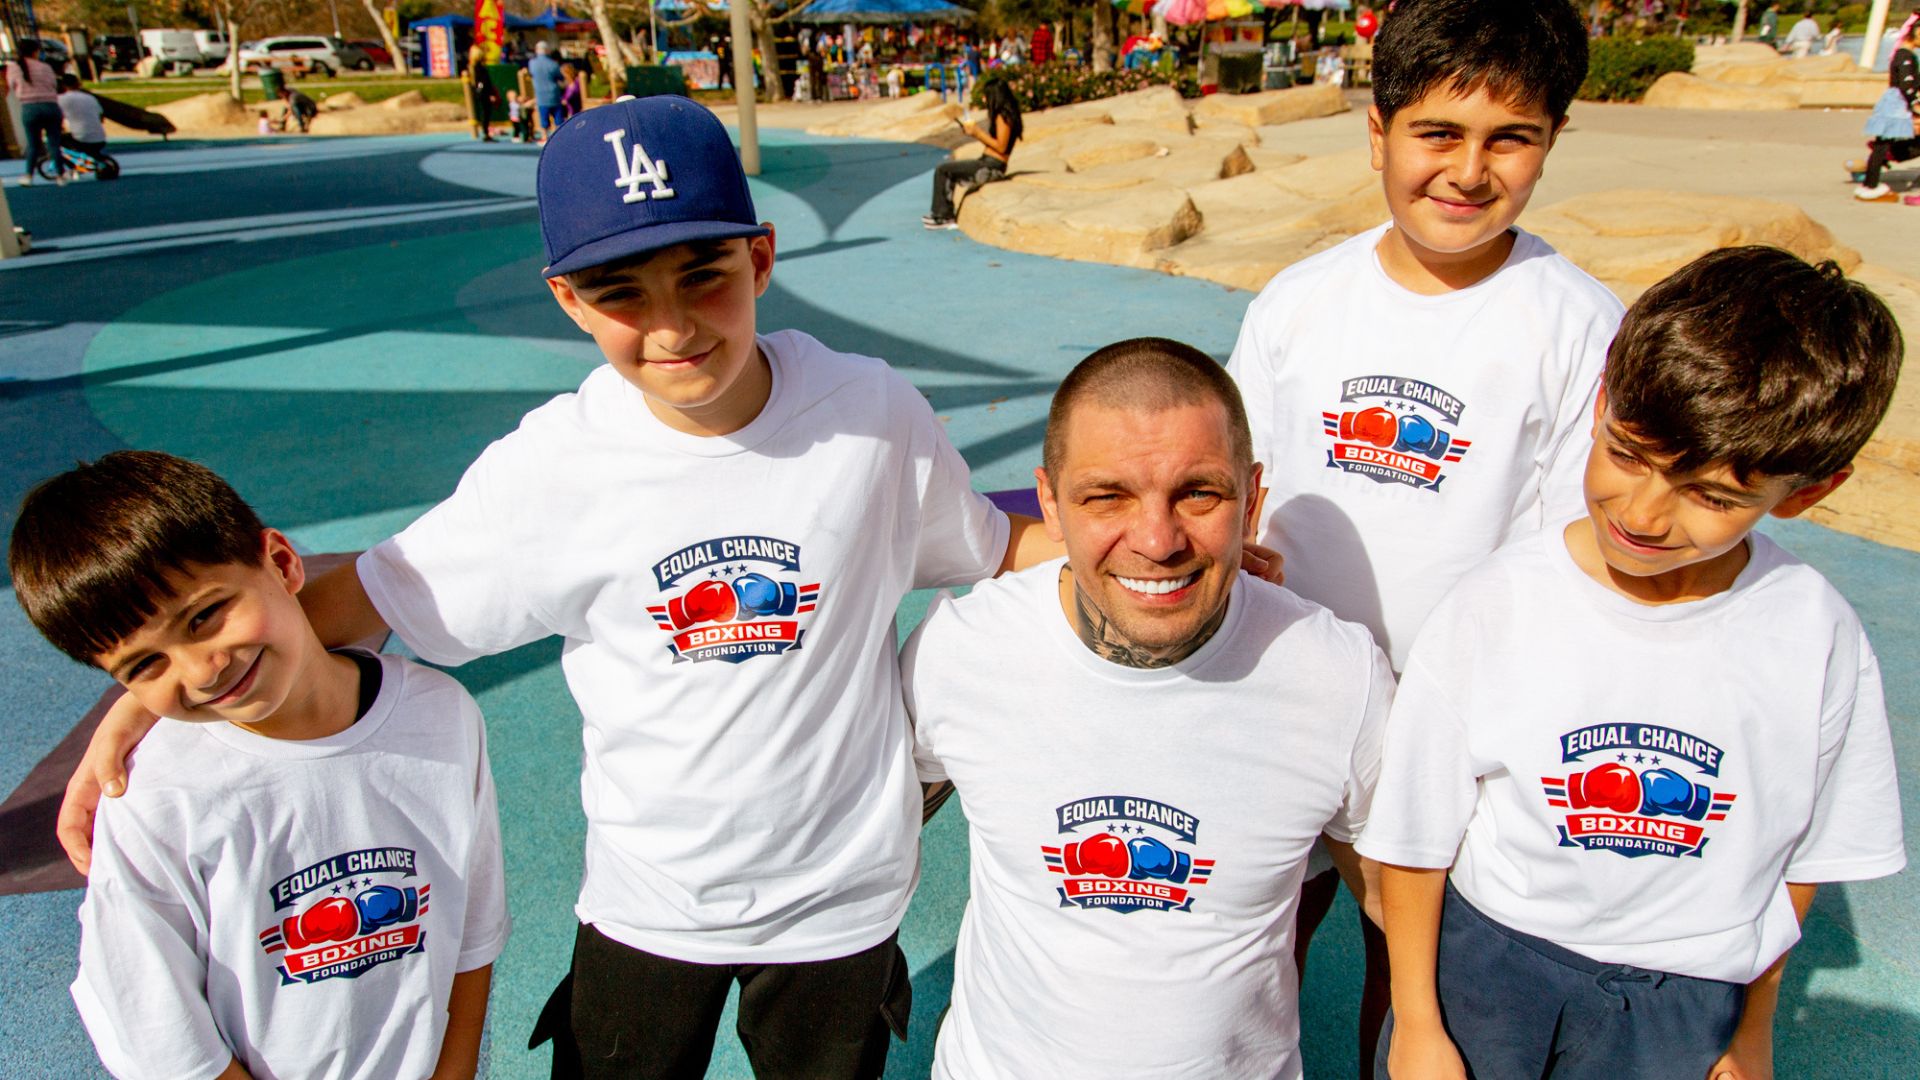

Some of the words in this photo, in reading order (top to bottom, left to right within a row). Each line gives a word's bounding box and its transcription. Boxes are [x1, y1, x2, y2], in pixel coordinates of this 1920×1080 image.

[603, 128, 675, 204] LA
[1346, 378, 1399, 396] EQUAL
[1403, 380, 1461, 418] CHANCE
[1344, 446, 1427, 475] BOXING
[1348, 463, 1417, 485] FOUNDATION
[659, 544, 718, 583] EQUAL
[721, 538, 797, 564] CHANCE
[688, 624, 782, 646] BOXING
[698, 643, 776, 659] FOUNDATION
[1567, 726, 1632, 755] EQUAL
[1638, 727, 1719, 769] CHANCE
[1062, 799, 1119, 826] EQUAL
[1124, 799, 1195, 836] CHANCE
[1579, 817, 1686, 840] BOXING
[1589, 837, 1676, 854] FOUNDATION
[278, 860, 344, 902] EQUAL
[347, 850, 414, 872] CHANCE
[1077, 881, 1171, 897] BOXING
[1086, 897, 1164, 908] FOUNDATION
[301, 931, 405, 968] BOXING
[312, 950, 397, 980] FOUNDATION
